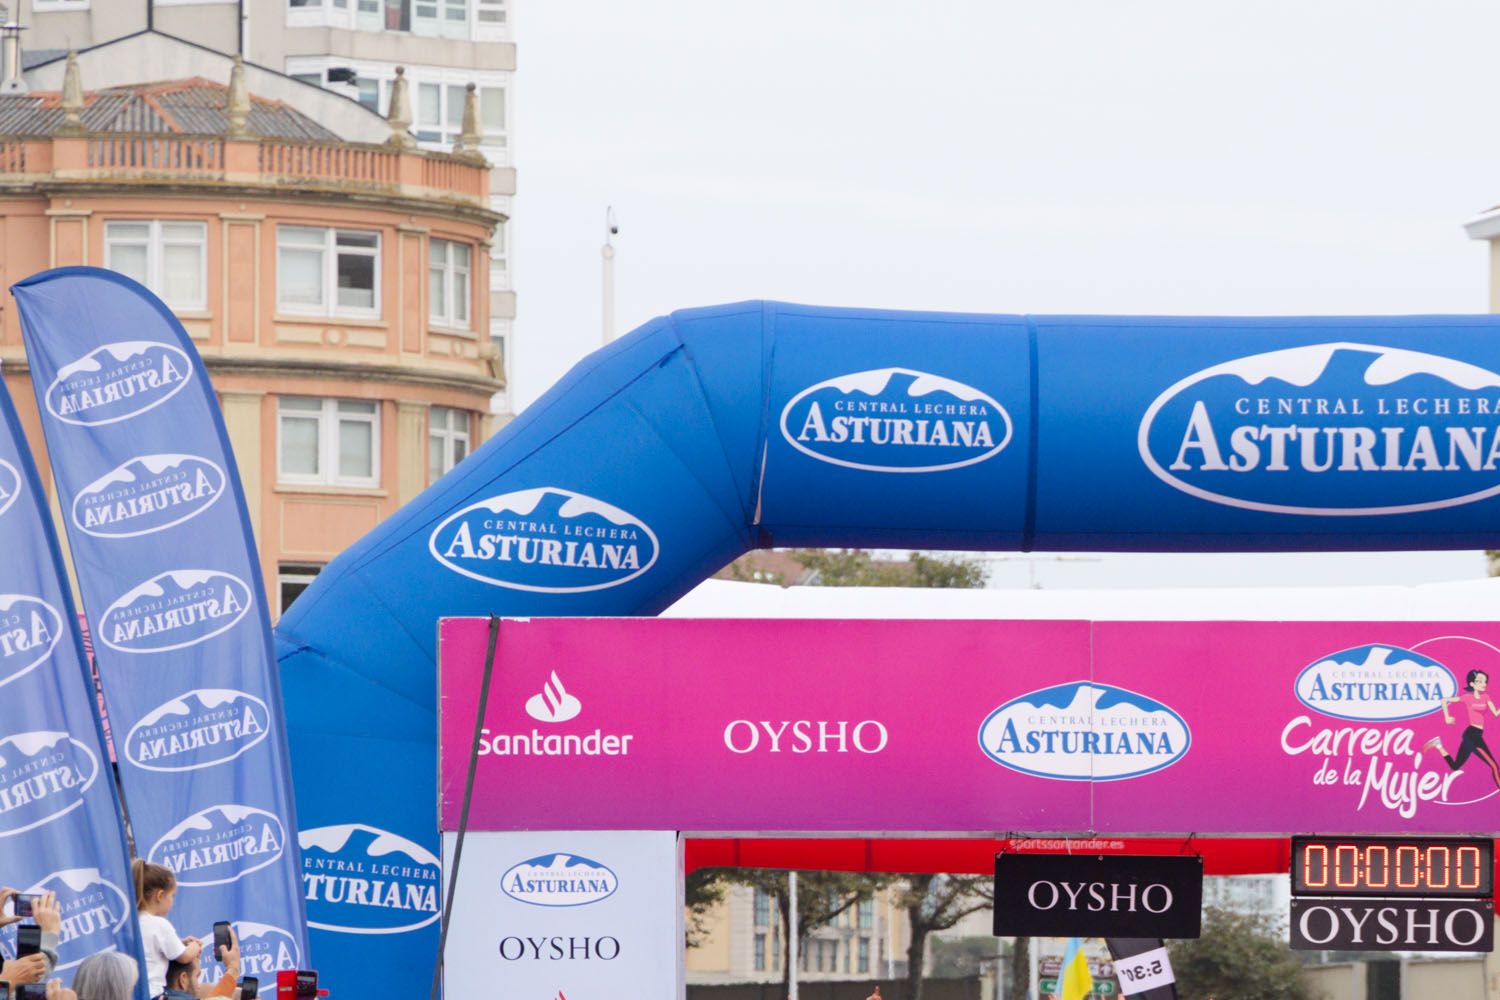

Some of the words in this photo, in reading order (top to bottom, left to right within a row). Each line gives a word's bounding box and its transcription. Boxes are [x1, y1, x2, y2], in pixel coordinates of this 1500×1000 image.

[834, 400, 908, 413] CENTRAL
[914, 403, 988, 416] LECHERA
[1235, 397, 1364, 415] CENTRAL
[797, 400, 995, 448] ASTURIANA
[443, 520, 641, 571] ASTURIANA
[483, 518, 557, 535] CENTRAL
[564, 524, 638, 540] LECHERA
[1306, 672, 1444, 701] ASTURIANA
[723, 719, 889, 754] OYSHO
[996, 717, 1175, 755] ASTURIANA
[1027, 716, 1093, 726] CENTRAL
[1101, 716, 1169, 727] LECHERA
[1280, 715, 1416, 757] Carrera
[477, 728, 634, 756] Santander
[1312, 756, 1339, 786] de
[1342, 756, 1363, 786] la
[1356, 751, 1465, 820] Mujer
[303, 857, 365, 873] ENTRAL
[371, 863, 437, 881] LECHERA
[509, 872, 610, 893] ASTURIANA
[1304, 845, 1481, 889] 00:00:00
[302, 872, 439, 913] TURIANA
[1027, 879, 1174, 914] OYSHO
[1299, 905, 1486, 946] OYSHO
[499, 935, 621, 961] OYSHO
